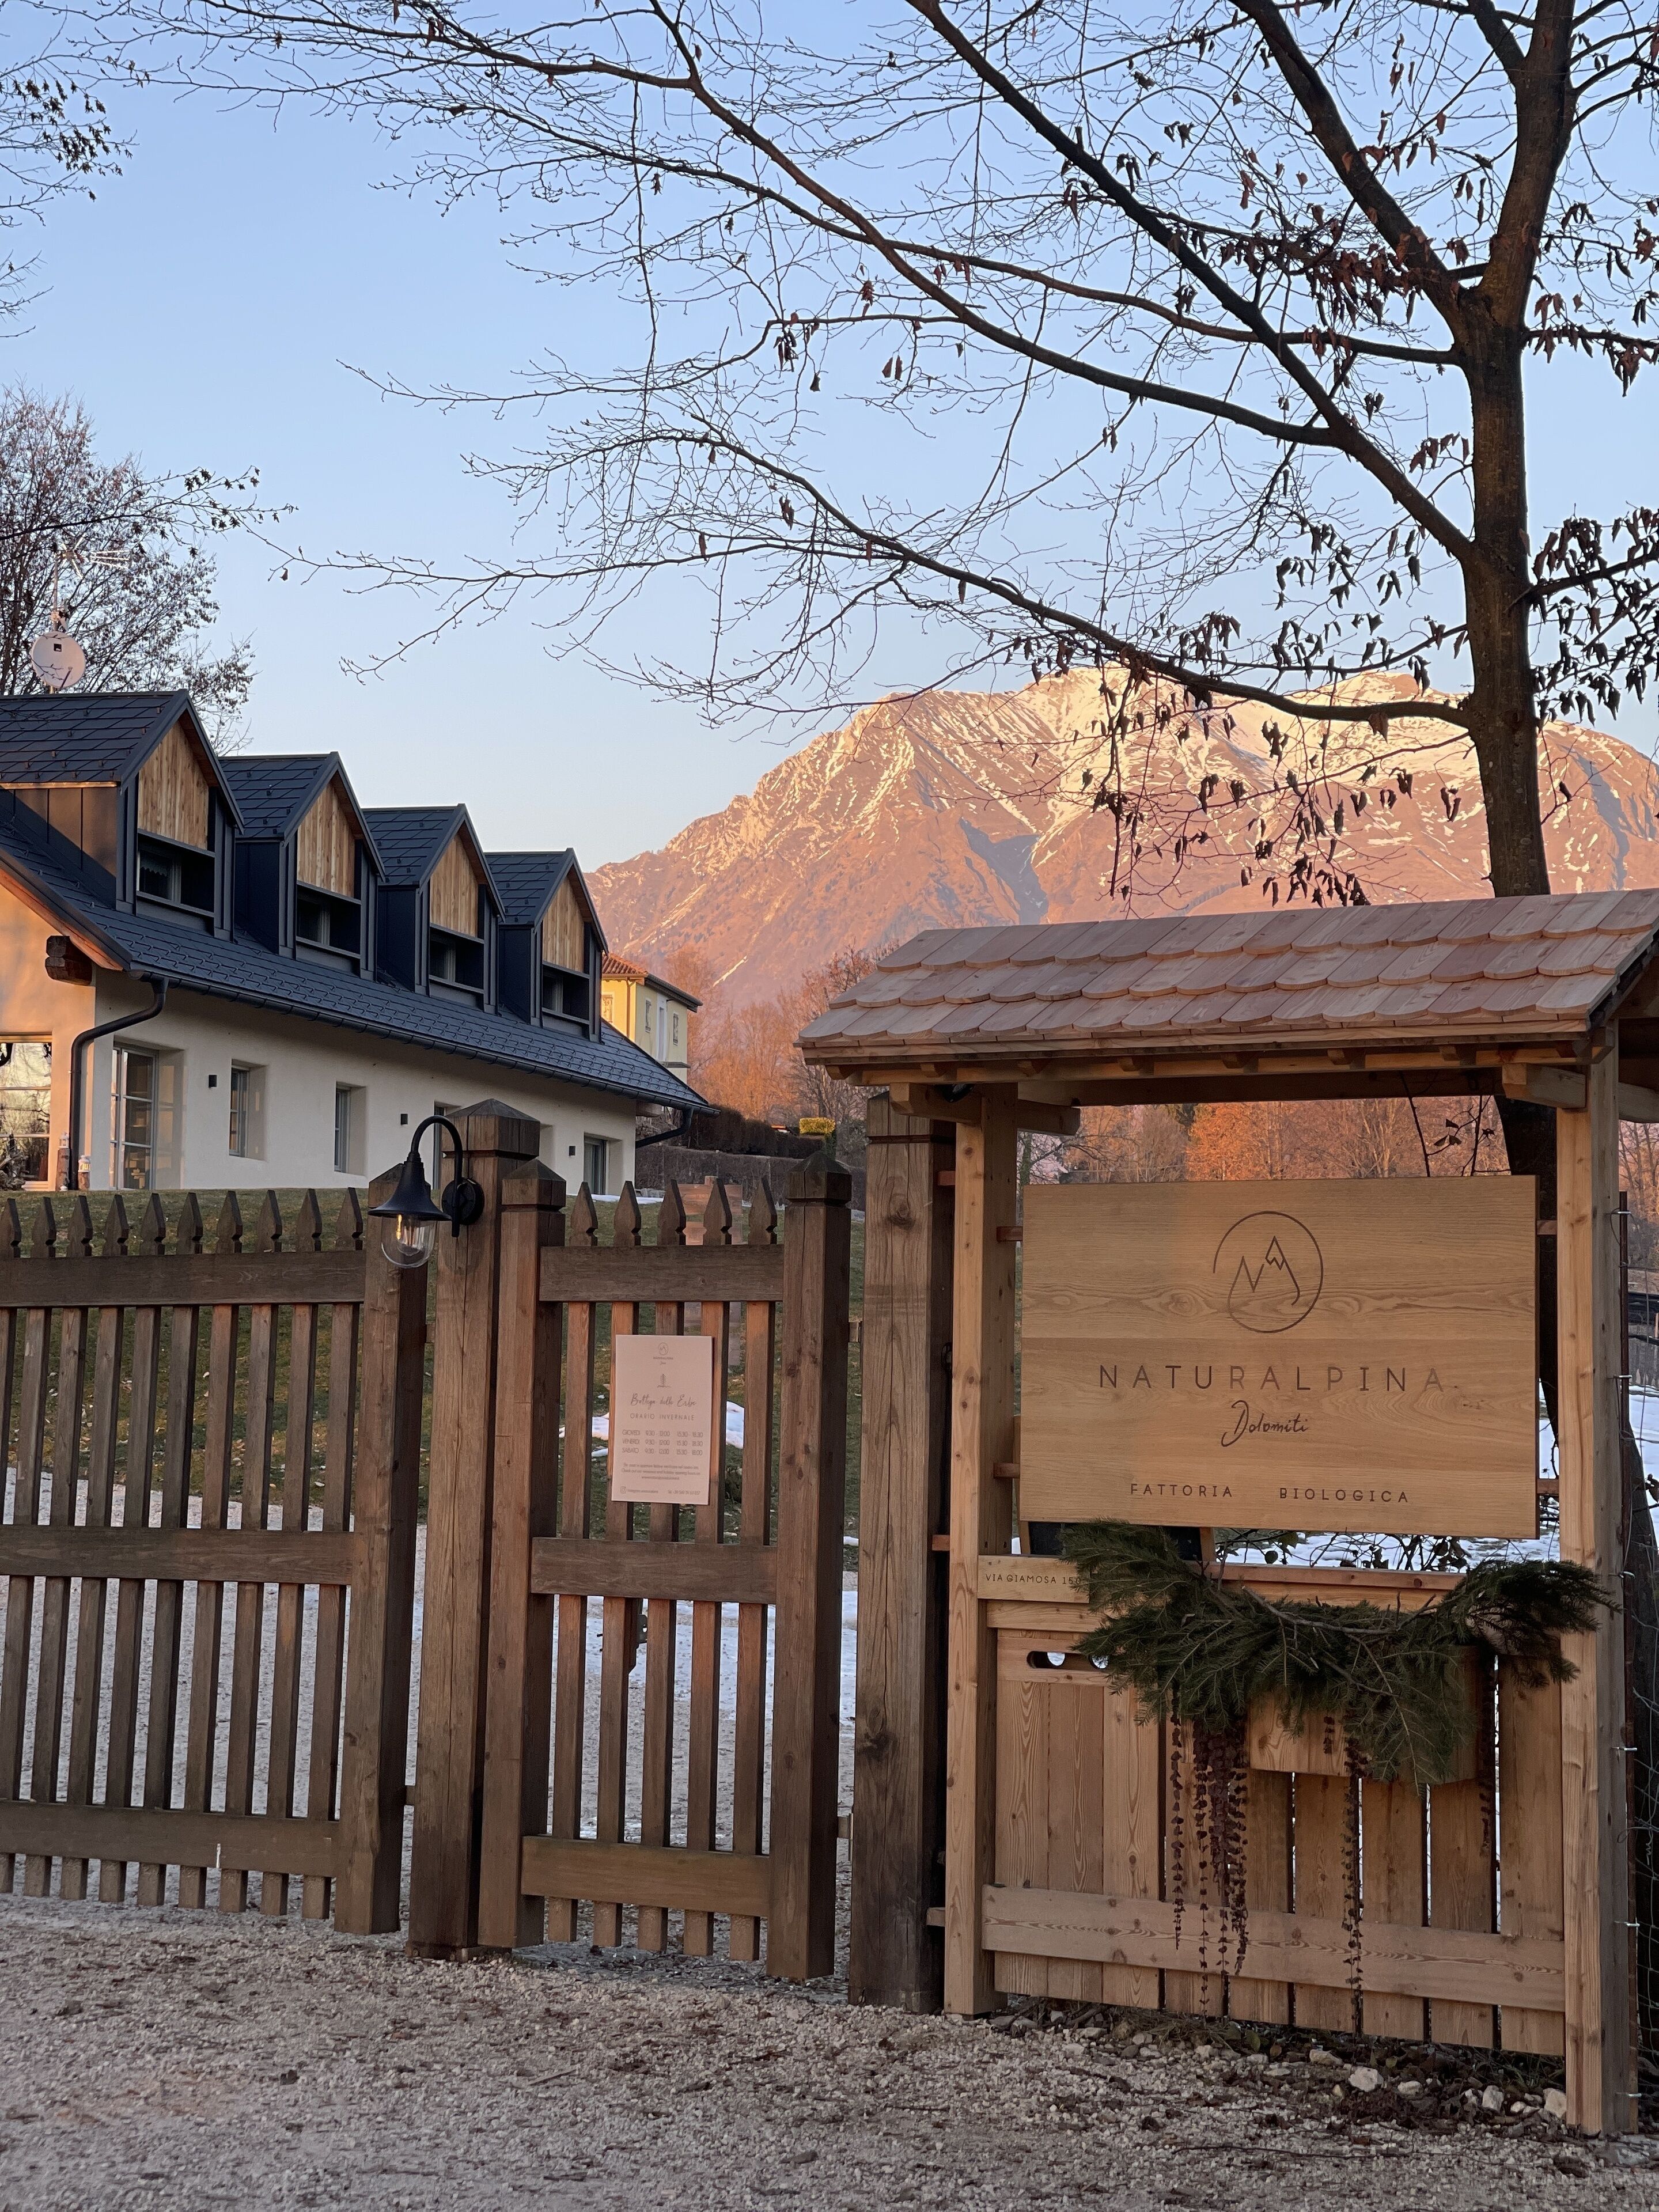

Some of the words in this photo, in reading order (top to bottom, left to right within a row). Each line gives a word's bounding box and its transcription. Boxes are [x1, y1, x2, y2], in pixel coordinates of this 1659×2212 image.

[1100, 1365, 1444, 1392] NATURALPINA
[677, 1394, 697, 1407] Erbe
[1221, 1400, 1309, 1448] Dolomiti
[1130, 1483, 1233, 1498] FATTORIA
[1279, 1487, 1408, 1503] BIOLOGICA
[986, 1574, 1003, 1582] VIA
[1006, 1574, 1056, 1584] GIAMOSA
[1062, 1577, 1081, 1585] 150
